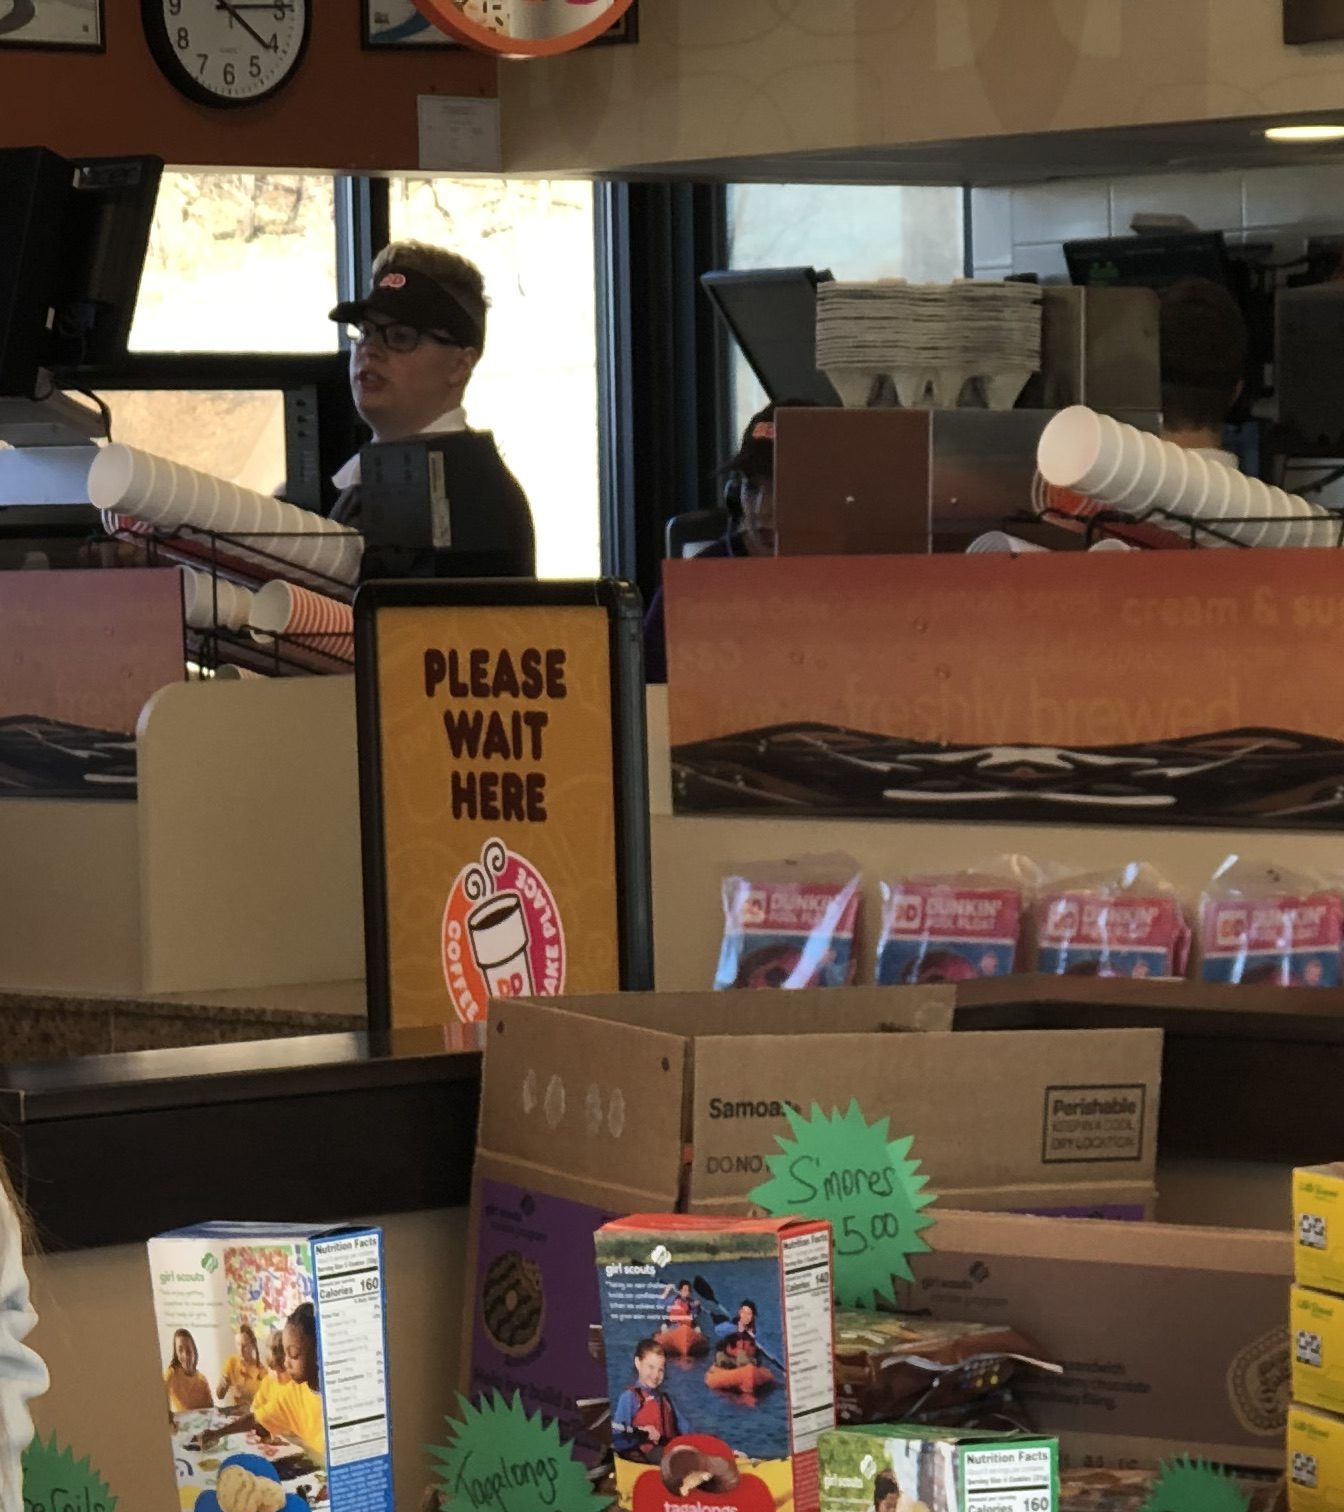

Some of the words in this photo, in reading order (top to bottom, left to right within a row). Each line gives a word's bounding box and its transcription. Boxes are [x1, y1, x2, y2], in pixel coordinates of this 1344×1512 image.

[177, 27, 189, 50] 8
[197, 54, 208, 74] 7
[249, 56, 262, 78] 5
[223, 62, 236, 86] 6
[1121, 597, 1238, 626] cream
[424, 648, 567, 699] PLEASE
[444, 709, 549, 760] WAIT
[451, 771, 548, 823] HERE
[787, 1155, 896, 1204] S'mores
[832, 1212, 899, 1256] 5.00
[315, 1241, 354, 1256] Nutrition
[354, 1237, 378, 1249] Facts
[159, 1270, 175, 1286] girl
[176, 1271, 206, 1283] scouts
[605, 1263, 622, 1277] girl
[624, 1264, 657, 1276] scouts
[319, 1286, 354, 1299] Calories
[360, 1276, 379, 1292] 160
[966, 1453, 1015, 1465] Nutrition
[1018, 1450, 1048, 1461] Facts
[1024, 1496, 1049, 1512] 160
